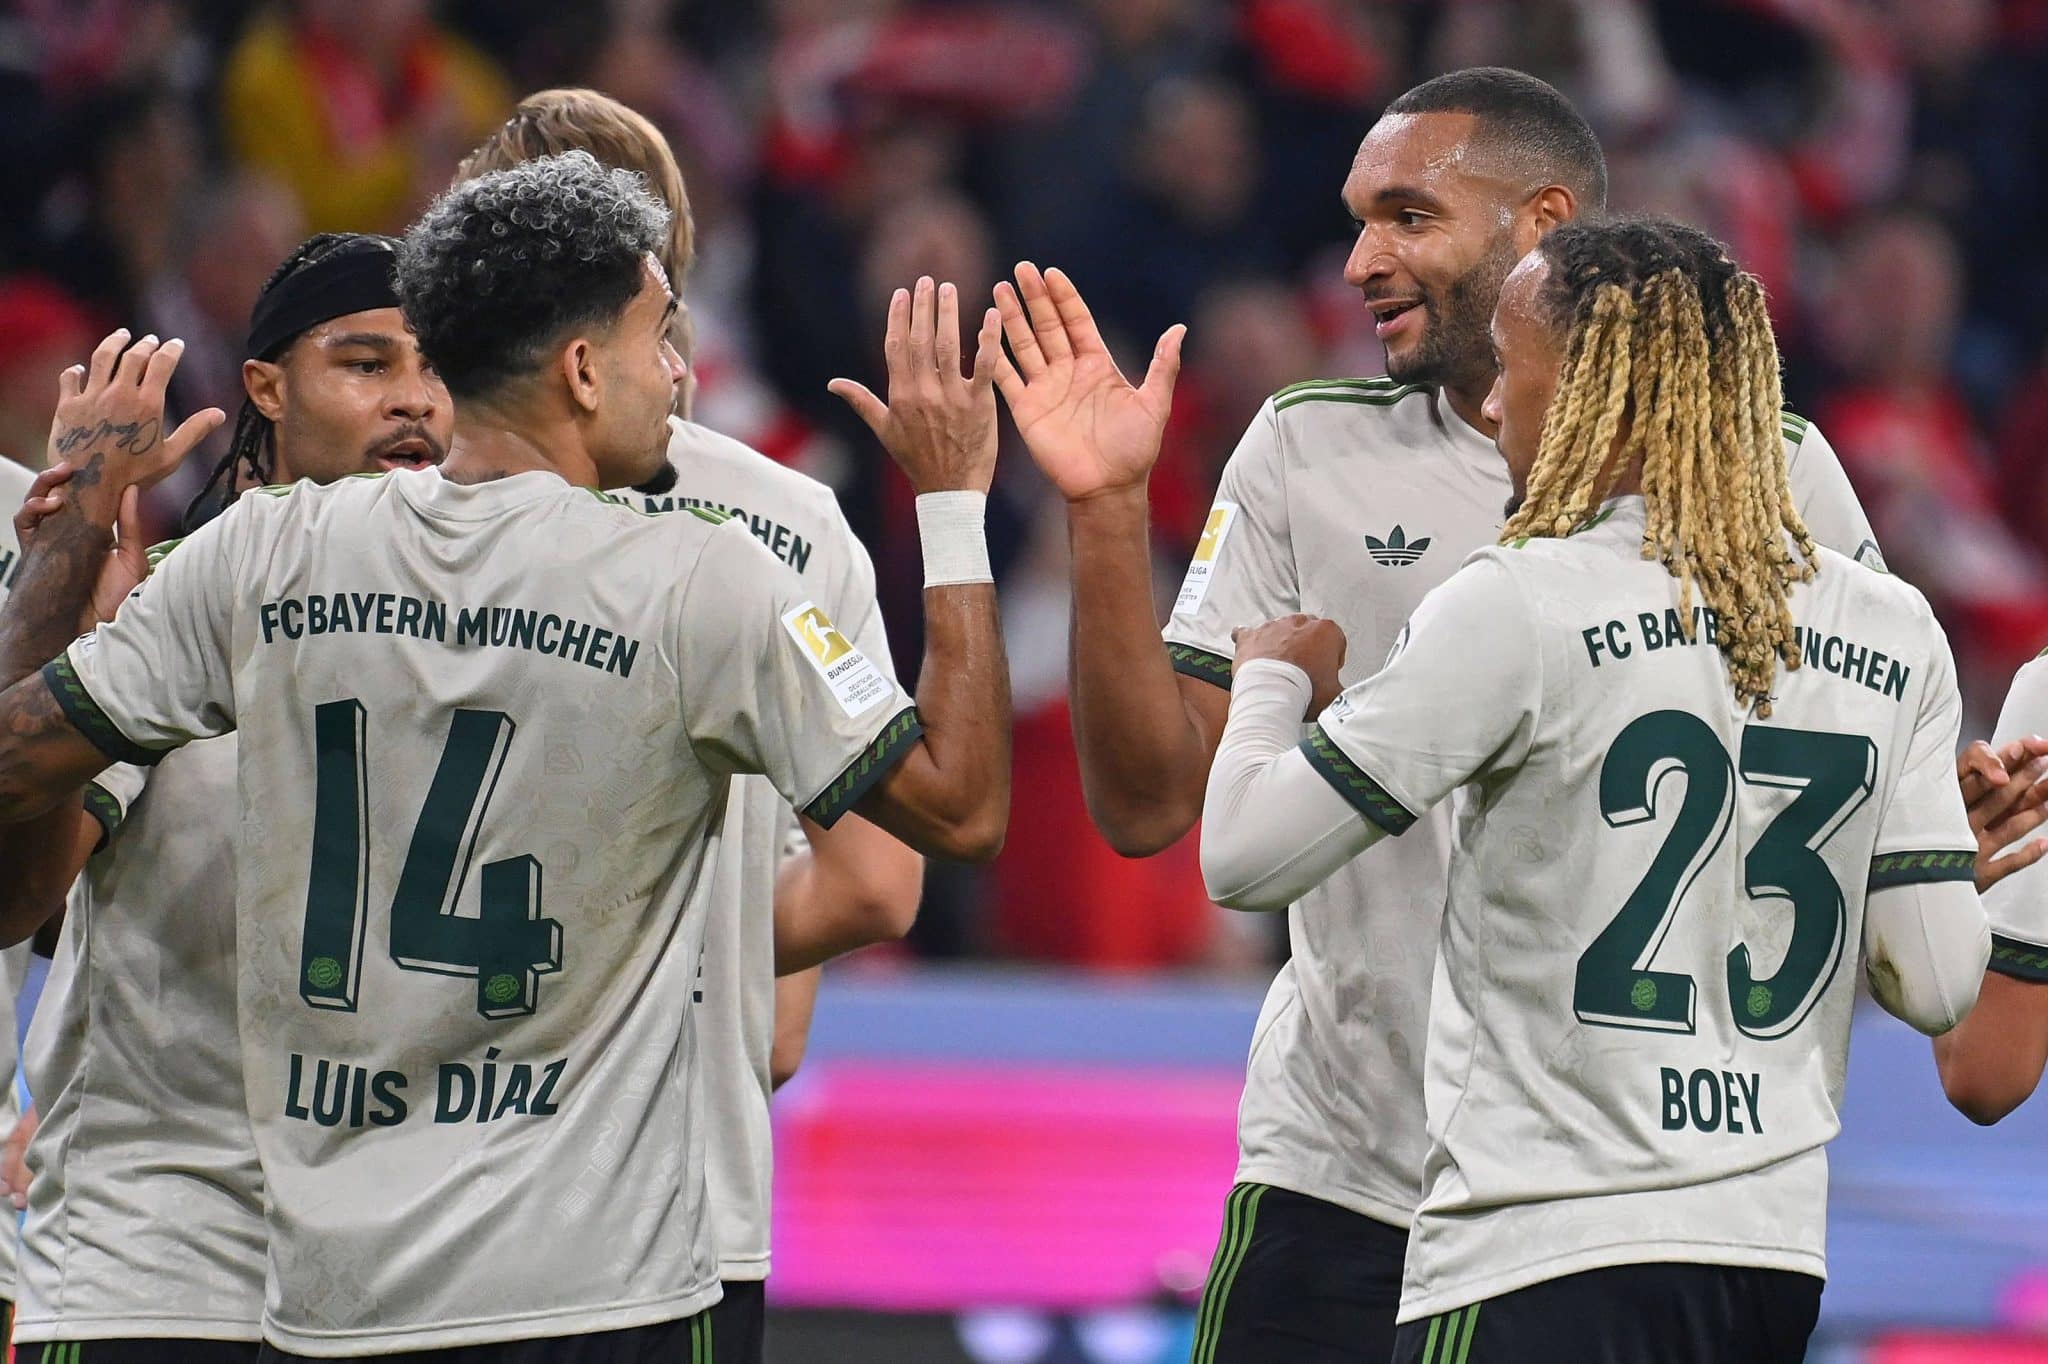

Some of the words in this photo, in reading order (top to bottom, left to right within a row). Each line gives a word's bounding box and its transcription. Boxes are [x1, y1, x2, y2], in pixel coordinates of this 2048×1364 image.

[456, 606, 640, 679] MÜNCHEN
[1581, 619, 1632, 668] FC
[300, 698, 564, 1021] 14
[1573, 709, 1878, 1042] 23
[285, 1053, 409, 1128] LUIS
[433, 1045, 568, 1125] DÍAZ
[1660, 1066, 1764, 1135] BOEY
